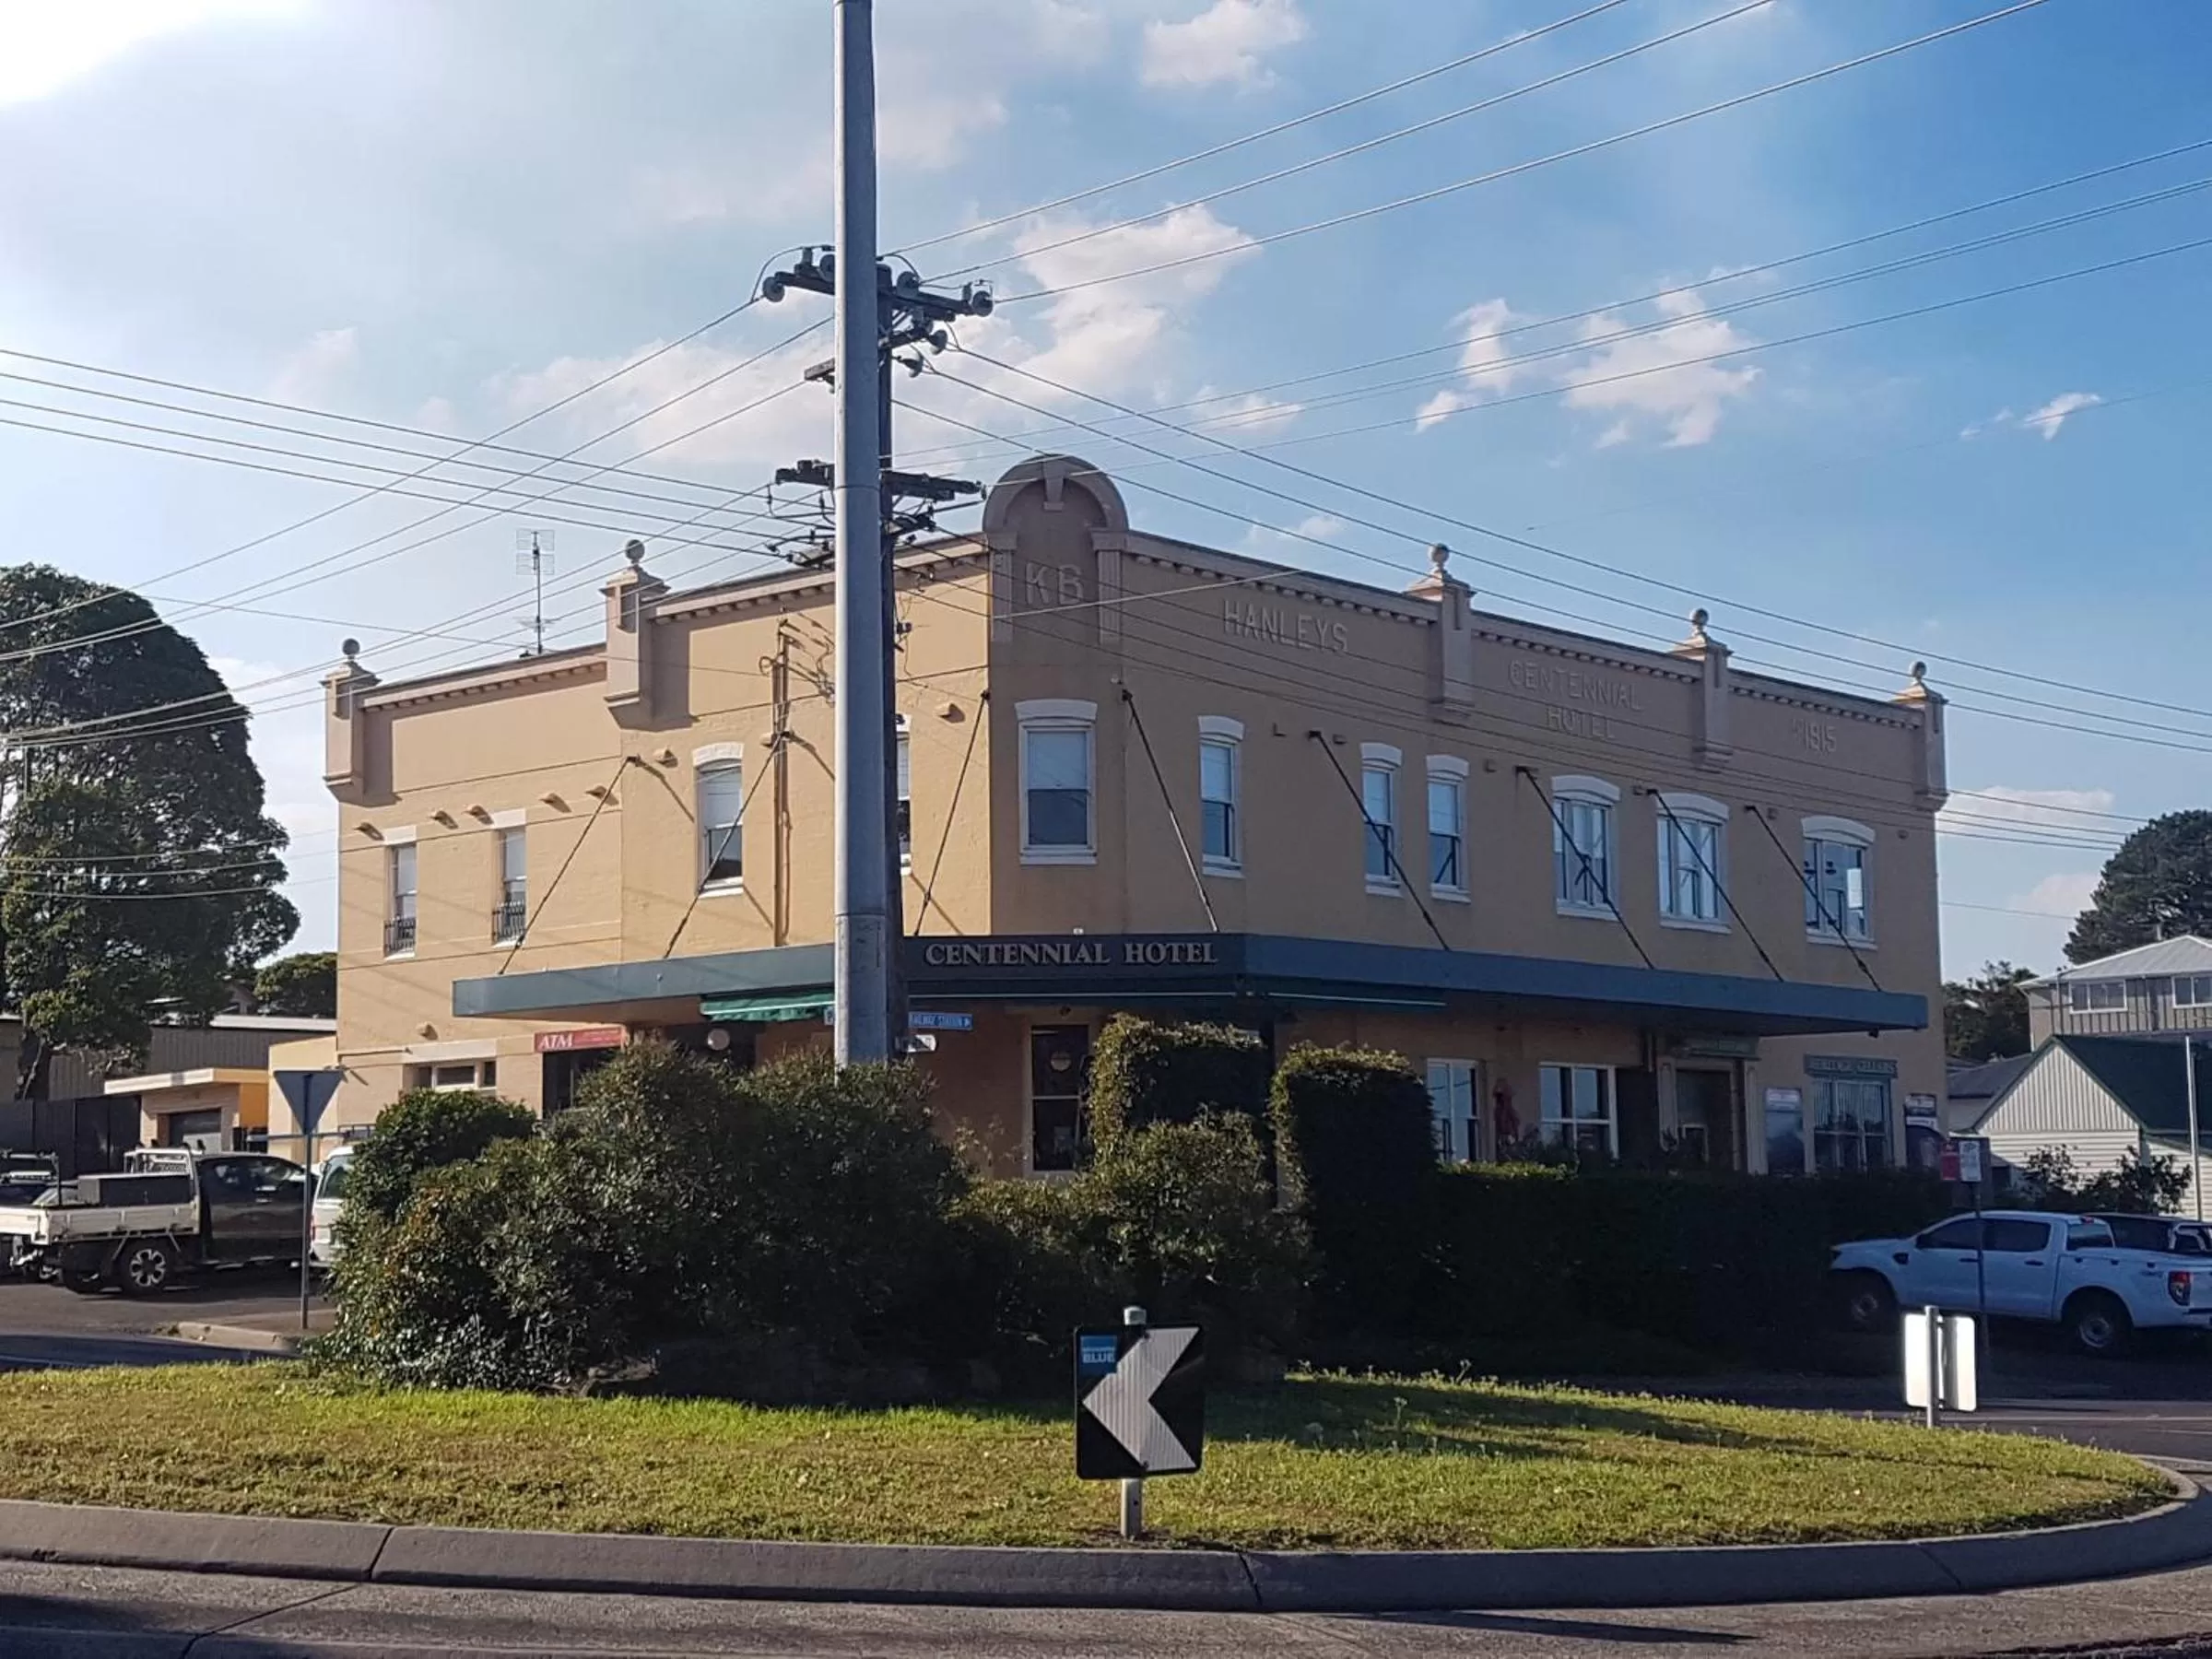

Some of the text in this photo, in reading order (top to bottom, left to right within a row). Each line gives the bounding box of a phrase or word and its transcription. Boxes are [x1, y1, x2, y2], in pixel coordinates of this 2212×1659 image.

[1223, 599, 1348, 653] HANLEYS
[1509, 660, 1644, 712] CENTENNIAL
[1547, 706, 1616, 739] HOTEL
[925, 942, 1218, 966] CENTENNIAL HOTEL
[537, 1033, 573, 1050] ATM
